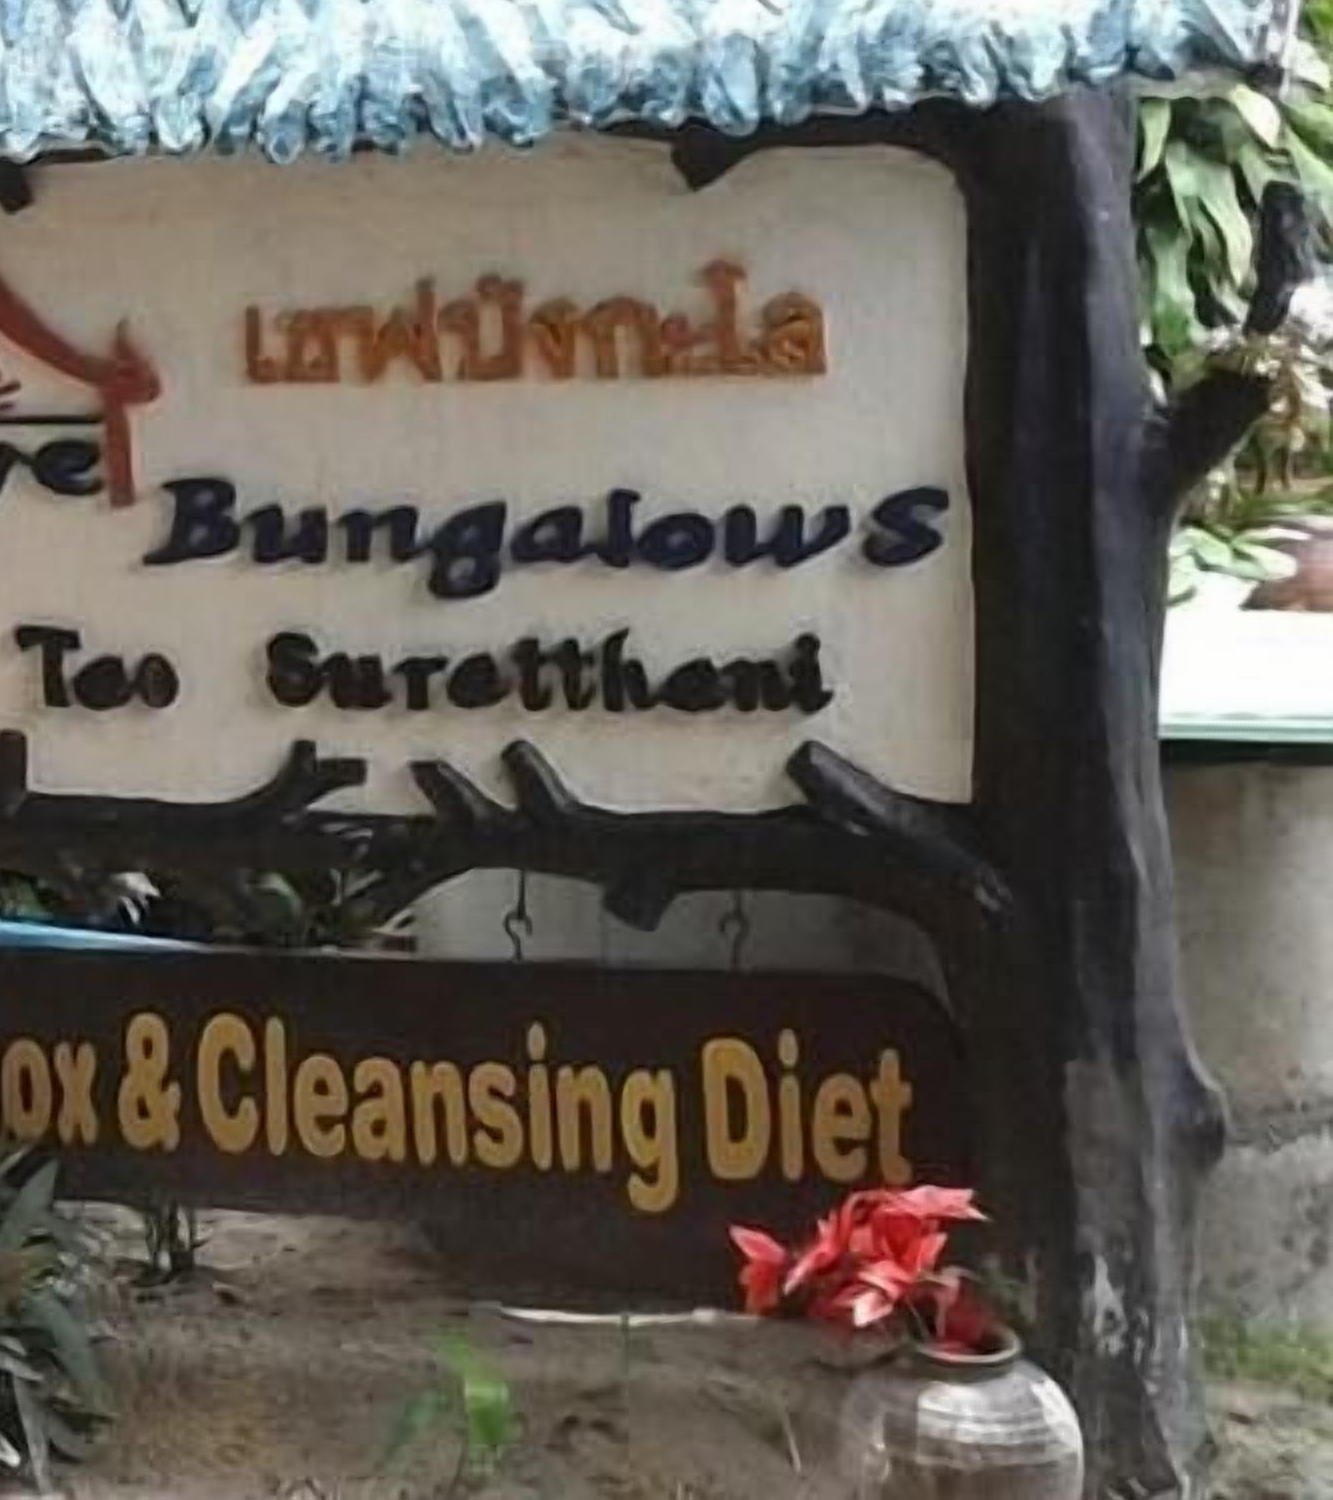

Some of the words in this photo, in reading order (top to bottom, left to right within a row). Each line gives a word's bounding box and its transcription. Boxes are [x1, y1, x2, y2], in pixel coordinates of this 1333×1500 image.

[142, 476, 949, 600] Bungalows
[15, 622, 180, 711] Tao
[264, 626, 834, 715] Suratthani
[118, 1011, 183, 1152] &
[196, 1012, 680, 1213] Cleansing
[700, 1028, 914, 1186] Diet
